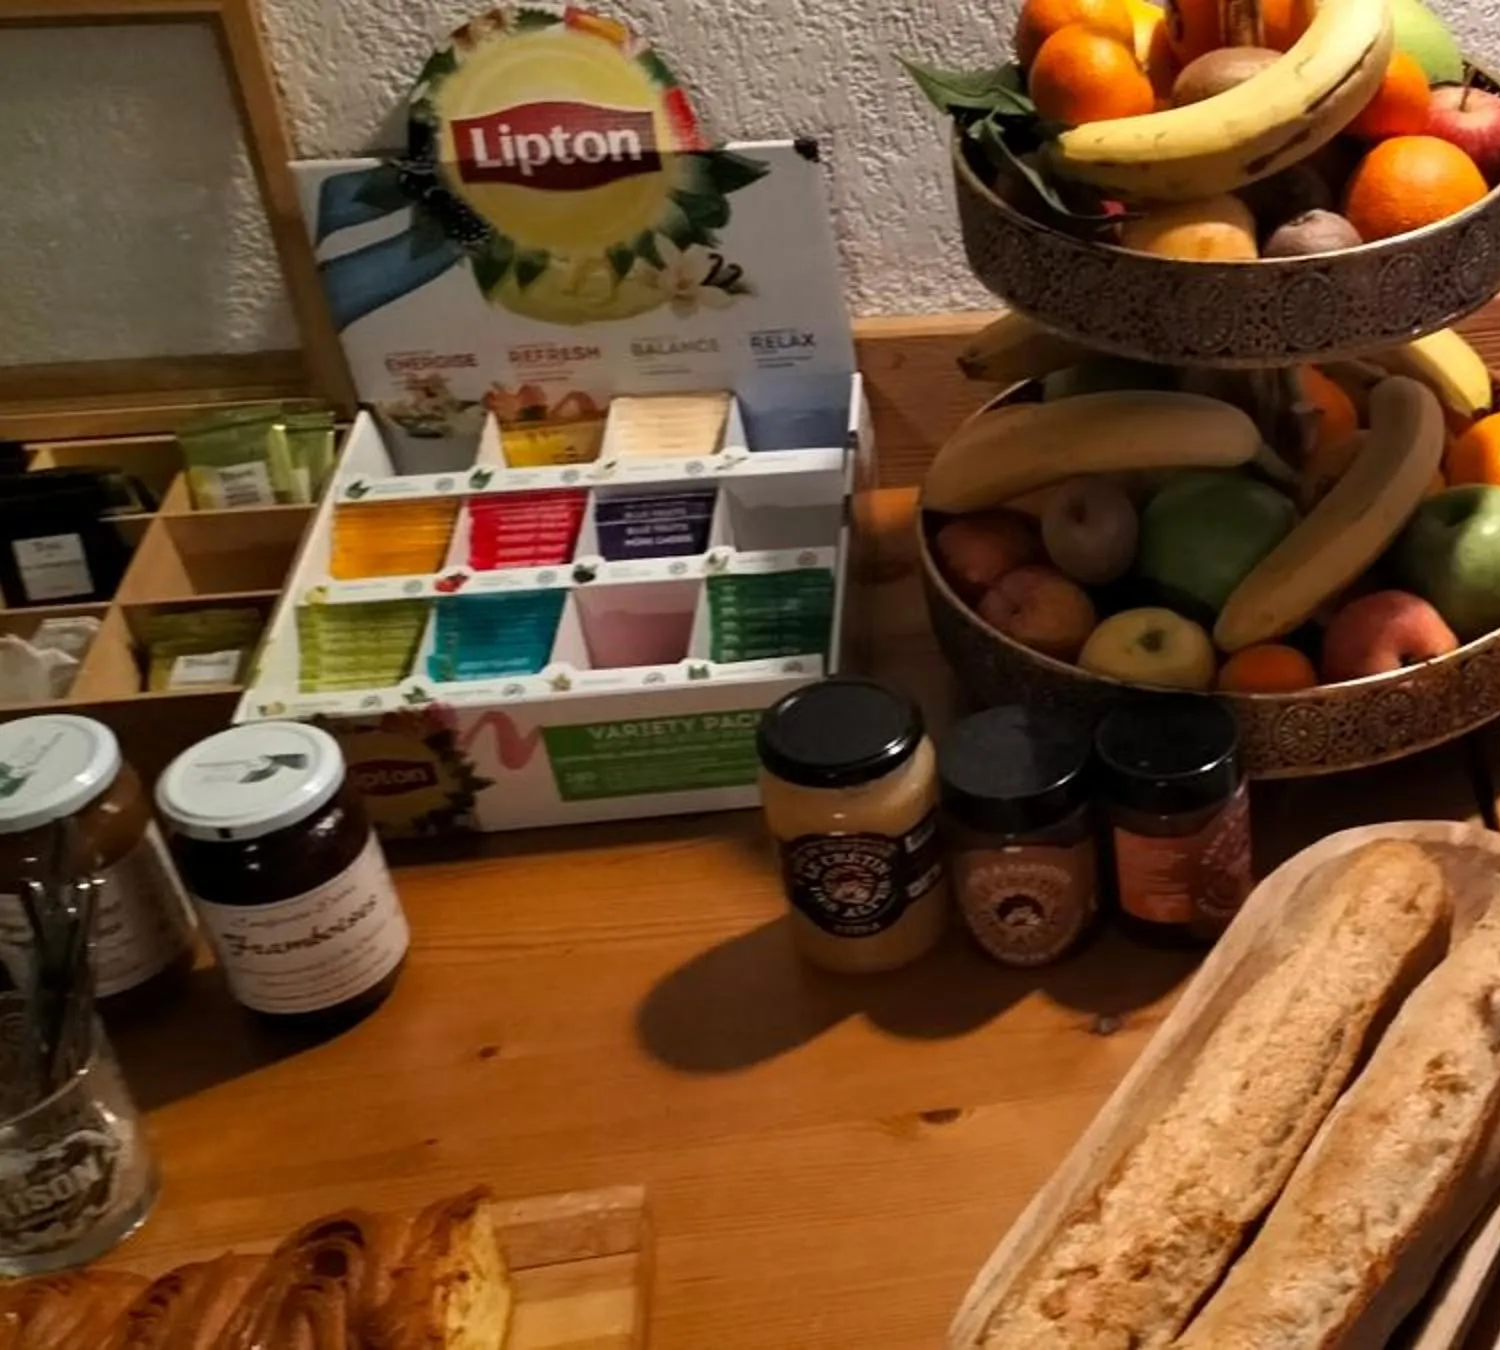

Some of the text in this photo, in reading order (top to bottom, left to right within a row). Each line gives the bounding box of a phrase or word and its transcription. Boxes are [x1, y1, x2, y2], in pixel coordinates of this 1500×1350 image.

[469, 123, 642, 176] Lipton
[750, 332, 816, 349] RELAX
[508, 345, 601, 363] REFRESH
[587, 717, 698, 740] VARIETY
[347, 766, 428, 790] ipton
